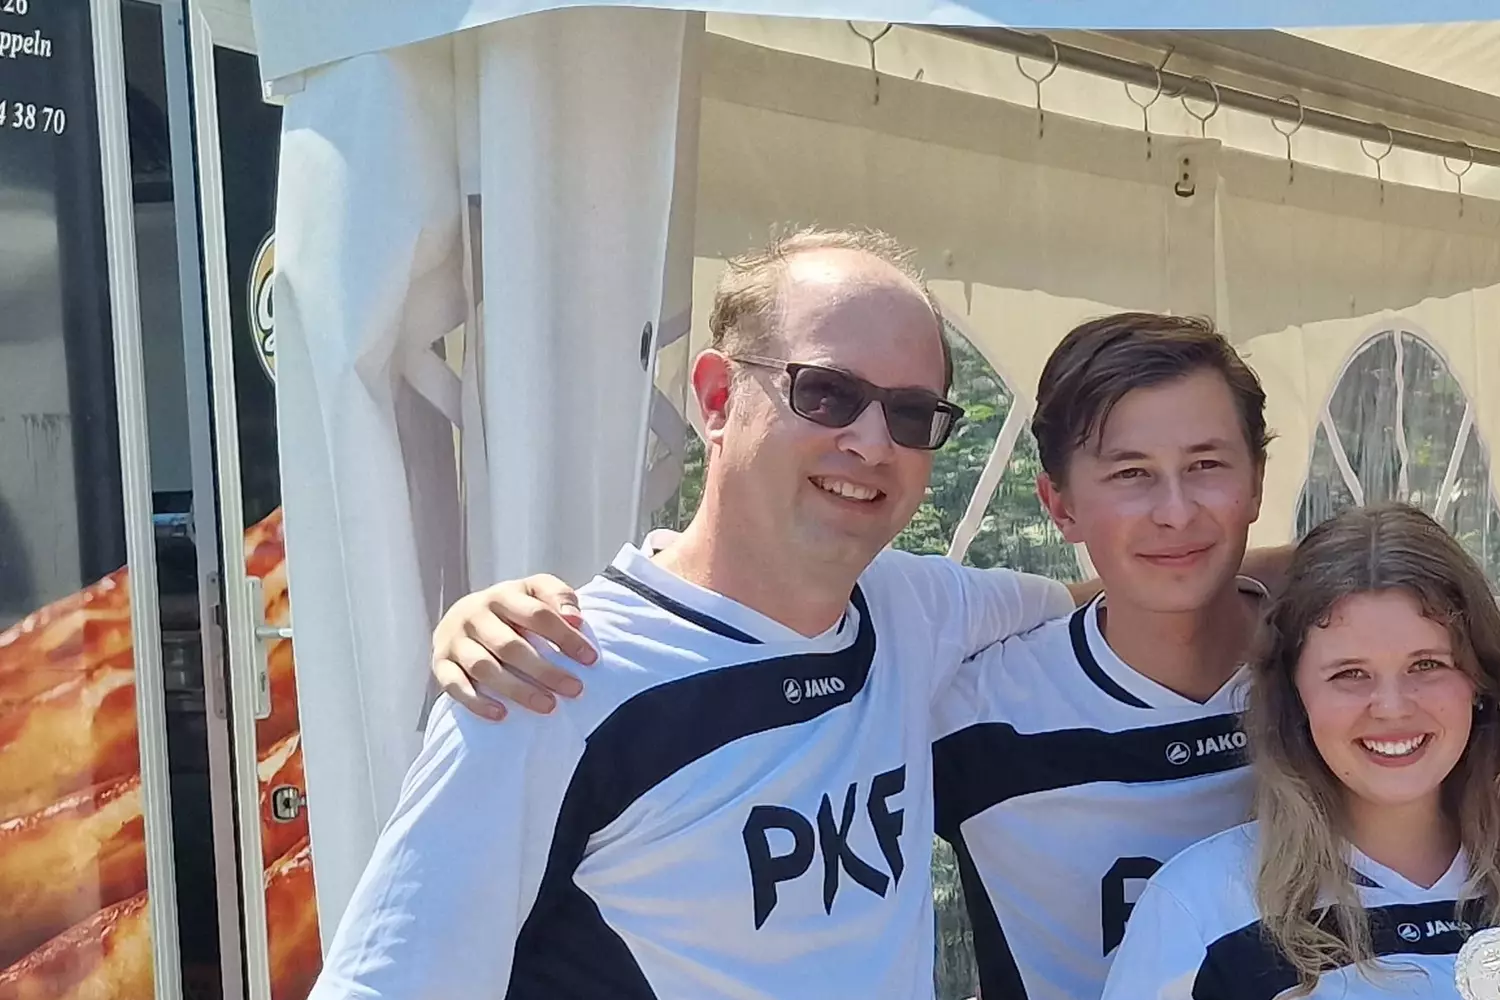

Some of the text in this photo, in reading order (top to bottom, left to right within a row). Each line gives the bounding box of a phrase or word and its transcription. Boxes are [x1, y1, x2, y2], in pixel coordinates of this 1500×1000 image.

[12, 102, 36, 130] 38
[42, 106, 66, 135] 70
[804, 676, 846, 698] JAKO
[1195, 731, 1247, 757] JAKO
[742, 763, 906, 931] PKF
